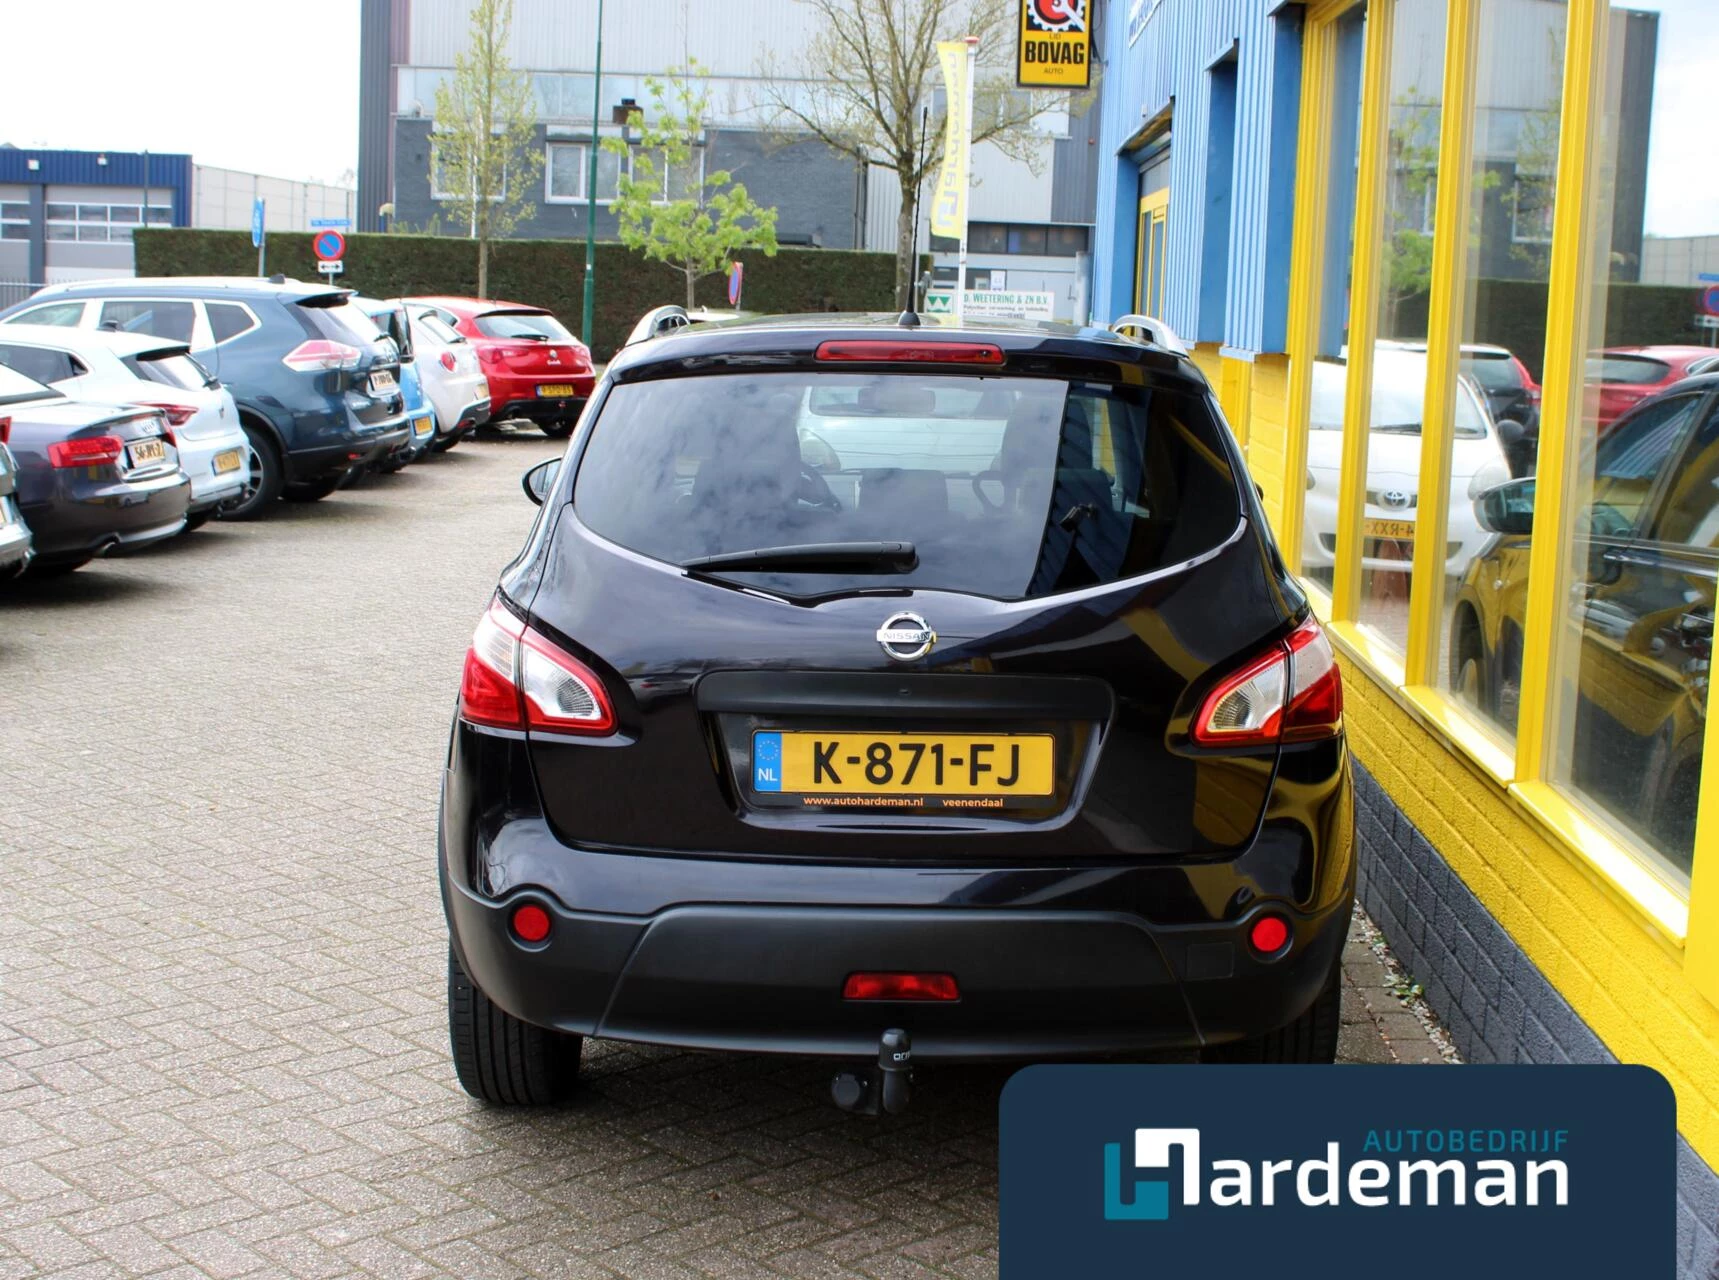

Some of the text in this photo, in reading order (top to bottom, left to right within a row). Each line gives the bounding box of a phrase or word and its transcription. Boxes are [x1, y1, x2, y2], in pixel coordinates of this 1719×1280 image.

[1025, 40, 1085, 64] BOVAG
[1043, 67, 1064, 75] AUTO
[973, 293, 1015, 305] WEETERING
[1017, 294, 1022, 304] &
[883, 631, 931, 642] NISSAN
[813, 741, 1020, 787] K-871-FJ
[757, 768, 778, 782] NL
[803, 796, 1004, 808] www.autohardeman.nl veenendaal
